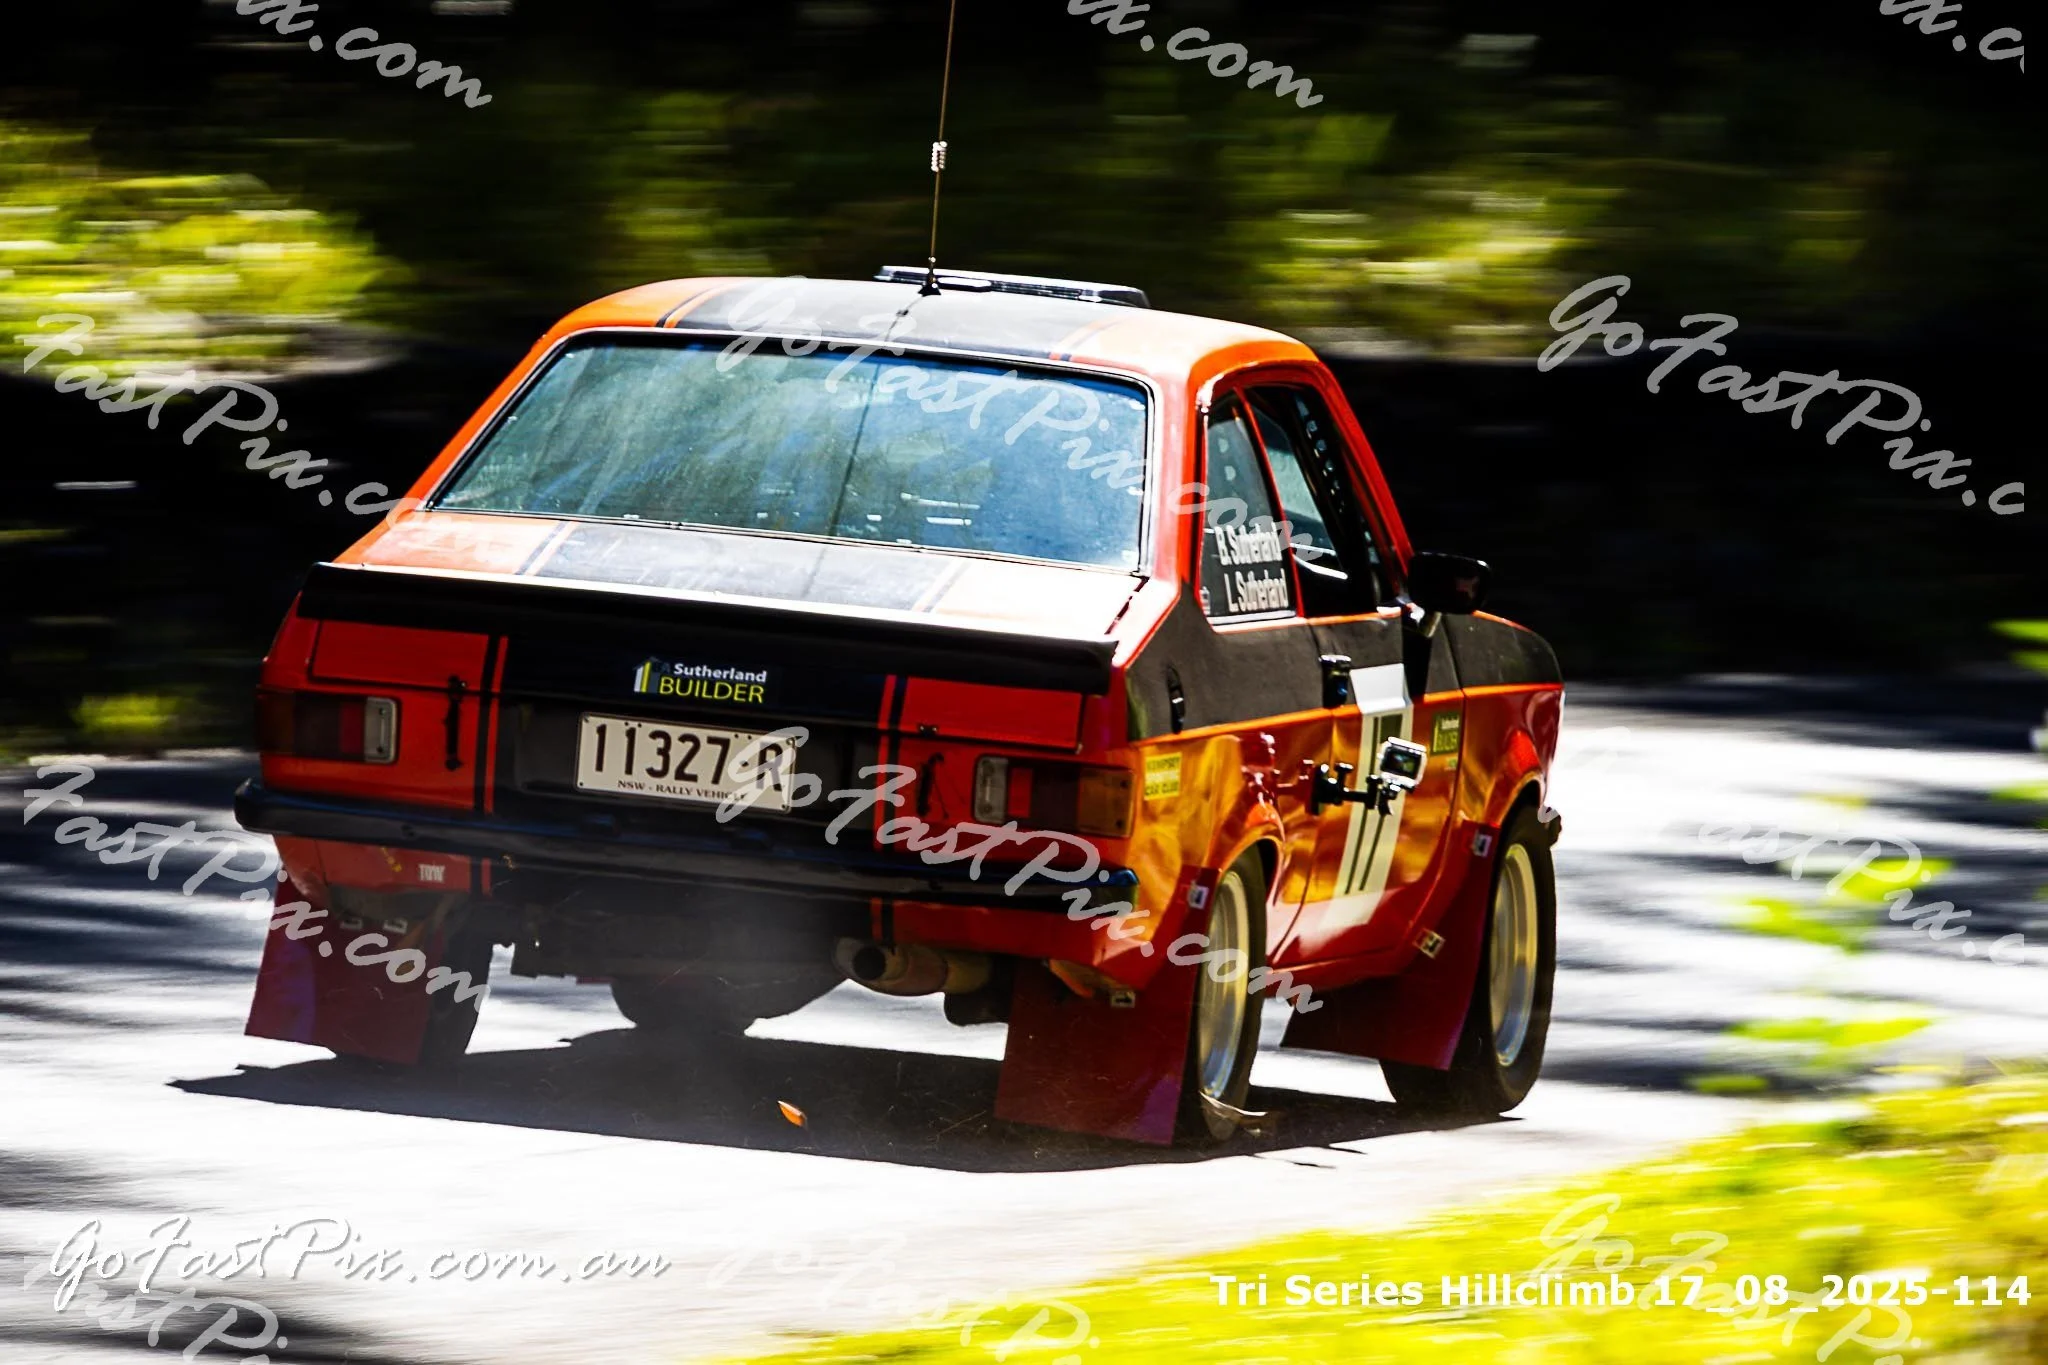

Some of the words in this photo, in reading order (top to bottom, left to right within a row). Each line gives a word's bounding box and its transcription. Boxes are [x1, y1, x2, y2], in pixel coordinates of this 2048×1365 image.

[673, 663, 768, 683] Sutherland
[659, 676, 765, 703] BUILDER
[617, 779, 646, 791] NSW
[656, 783, 694, 796] RALLY
